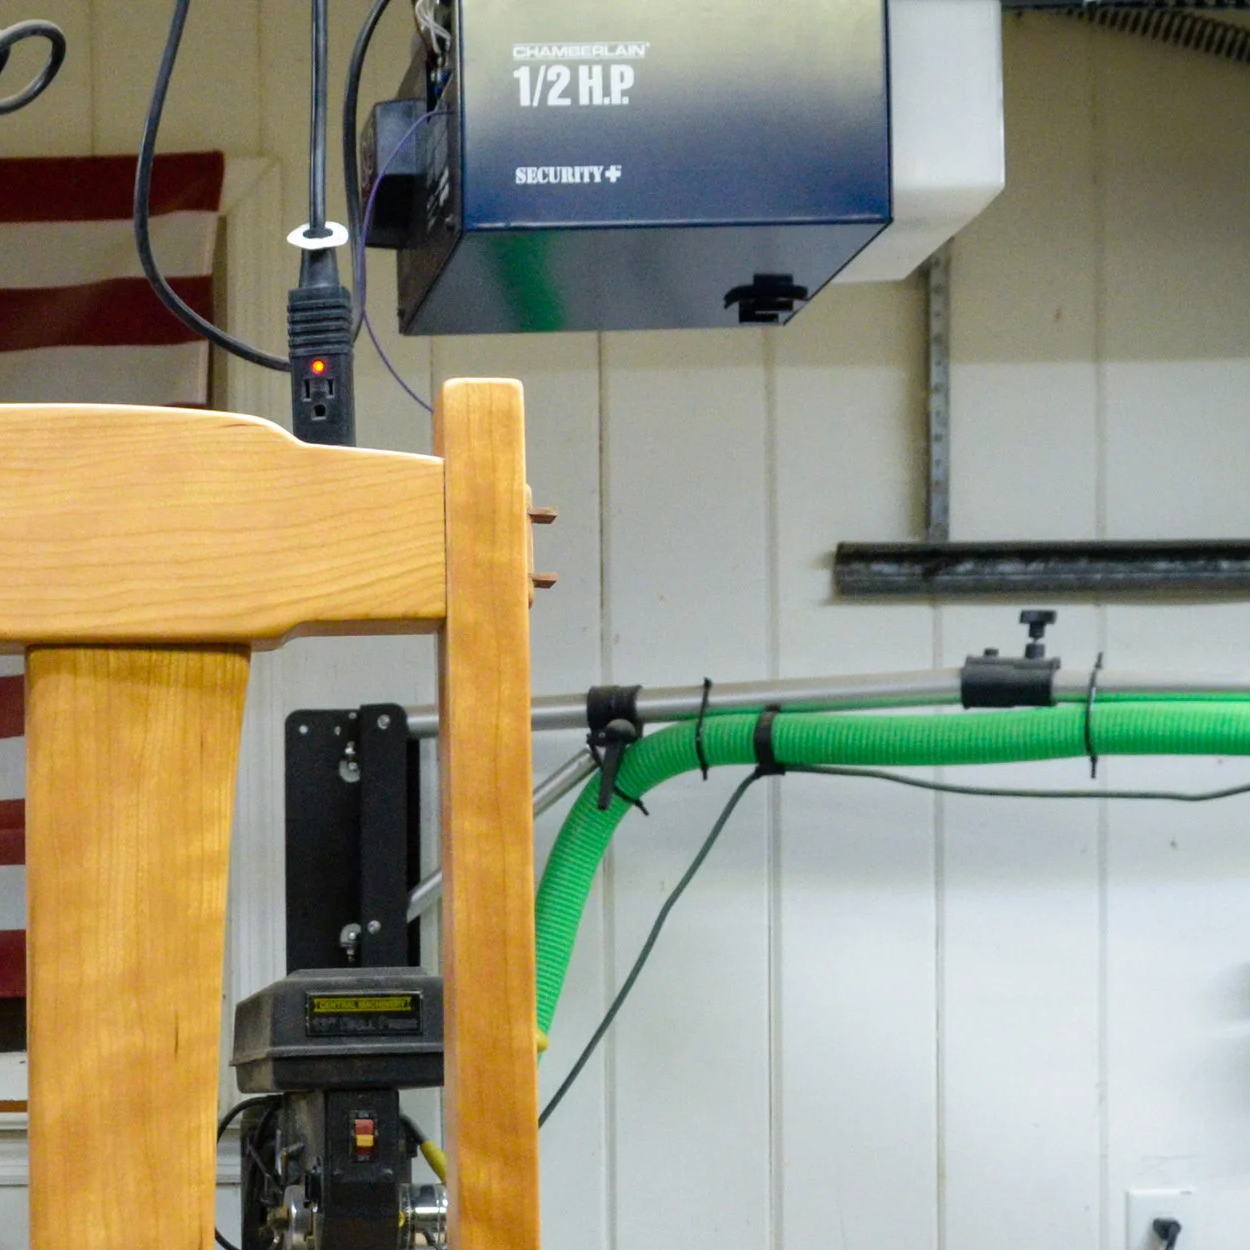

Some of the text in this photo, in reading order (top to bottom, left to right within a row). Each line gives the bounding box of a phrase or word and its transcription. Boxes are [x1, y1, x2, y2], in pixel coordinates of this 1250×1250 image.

[512, 43, 646, 58] CHAMBERLAIN
[513, 64, 635, 107] 1/2 H.P.
